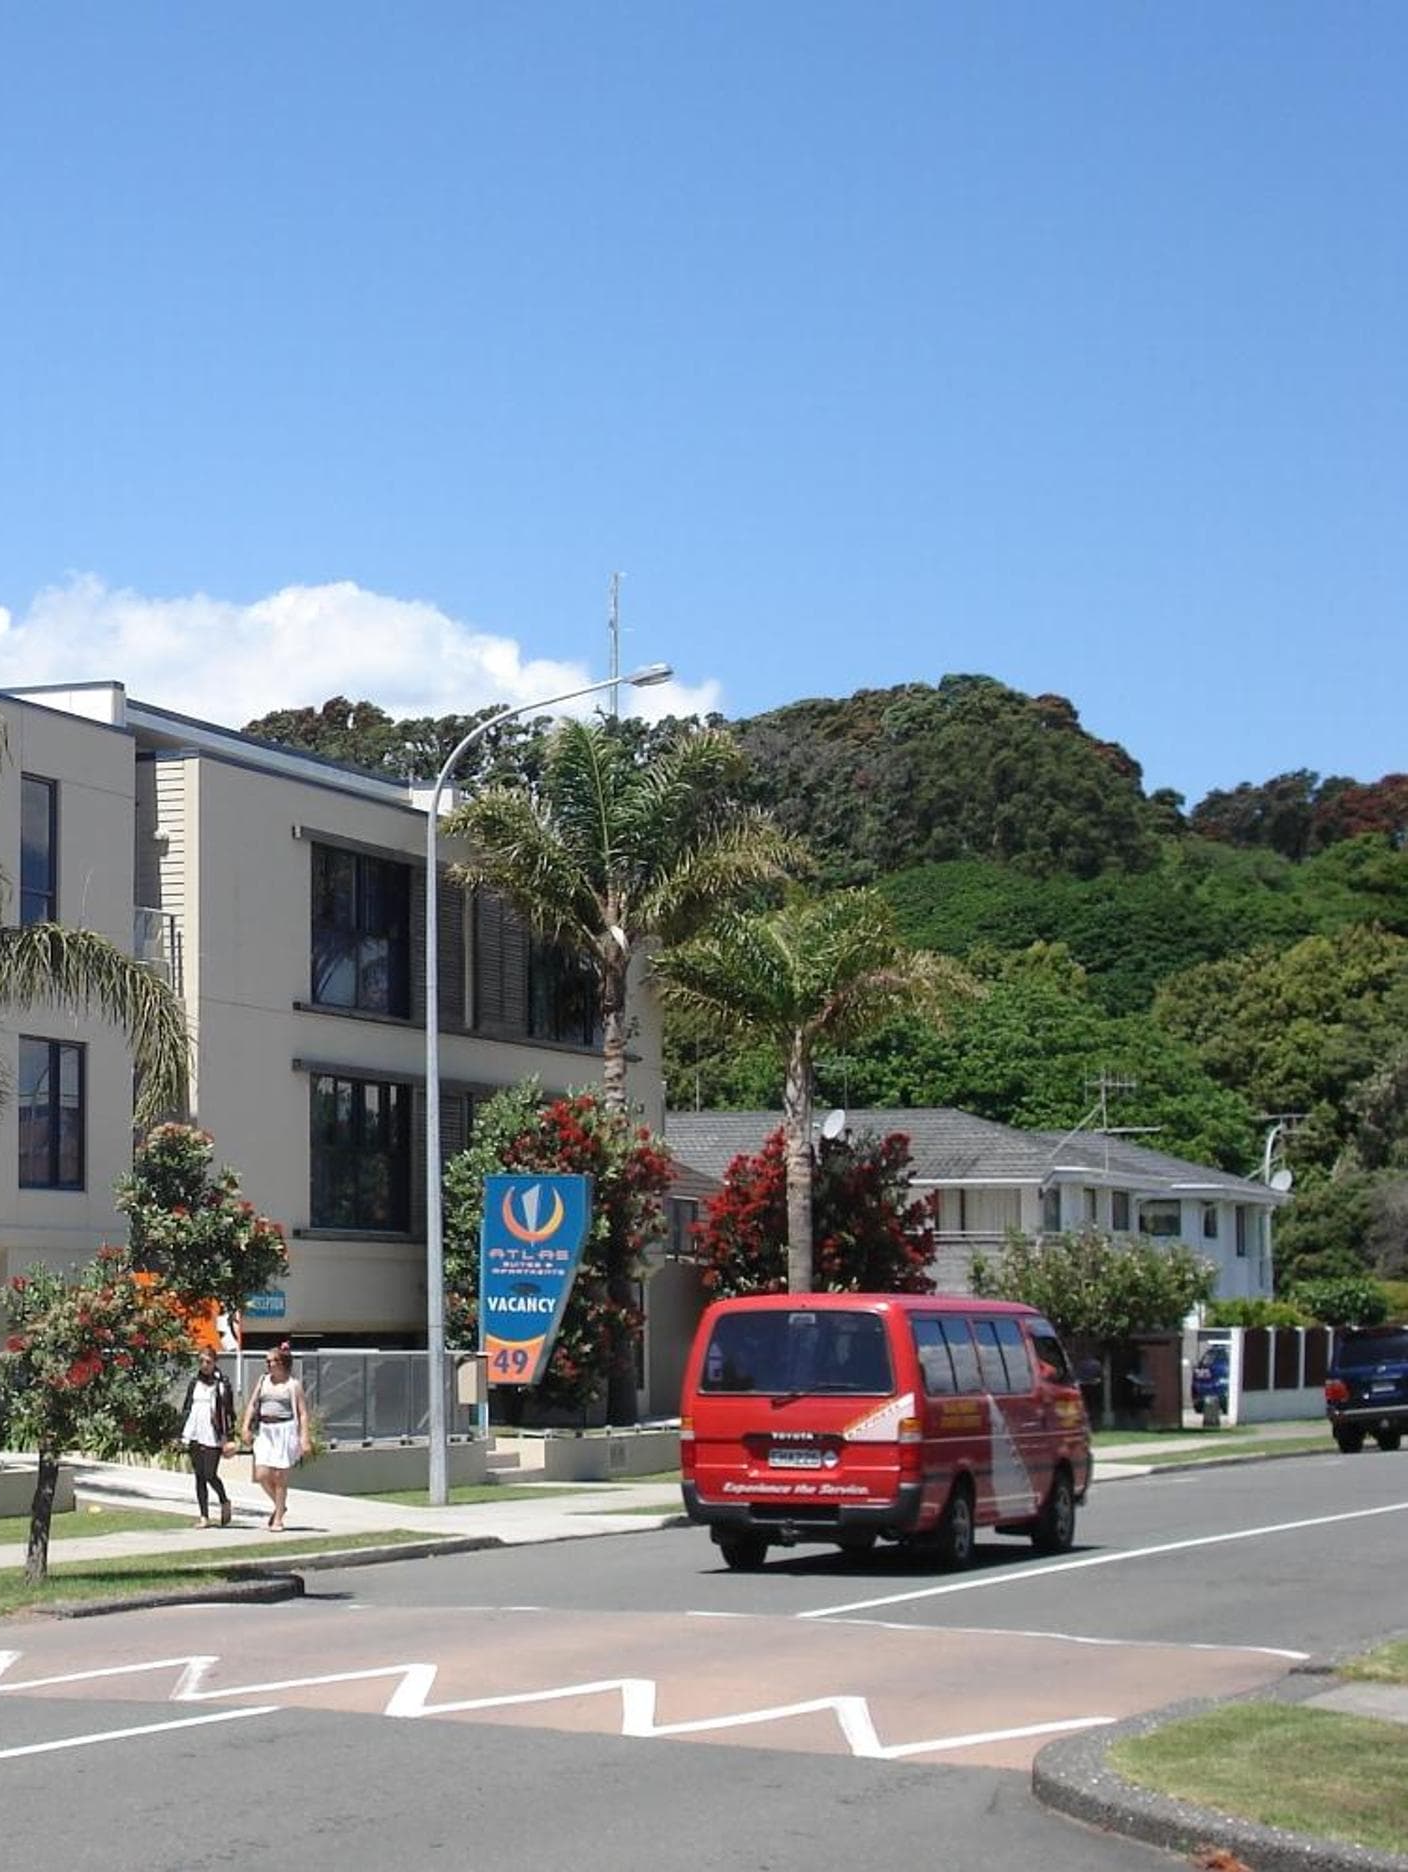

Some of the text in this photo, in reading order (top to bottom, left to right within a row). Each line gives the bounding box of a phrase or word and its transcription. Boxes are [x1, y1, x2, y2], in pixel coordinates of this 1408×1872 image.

[489, 1248, 569, 1260] ATLAS
[487, 1296, 557, 1313] VACANCY
[493, 1349, 529, 1375] 49
[772, 1431, 814, 1440] TOYOTA
[723, 1481, 792, 1495] Experience
[794, 1482, 817, 1495] the
